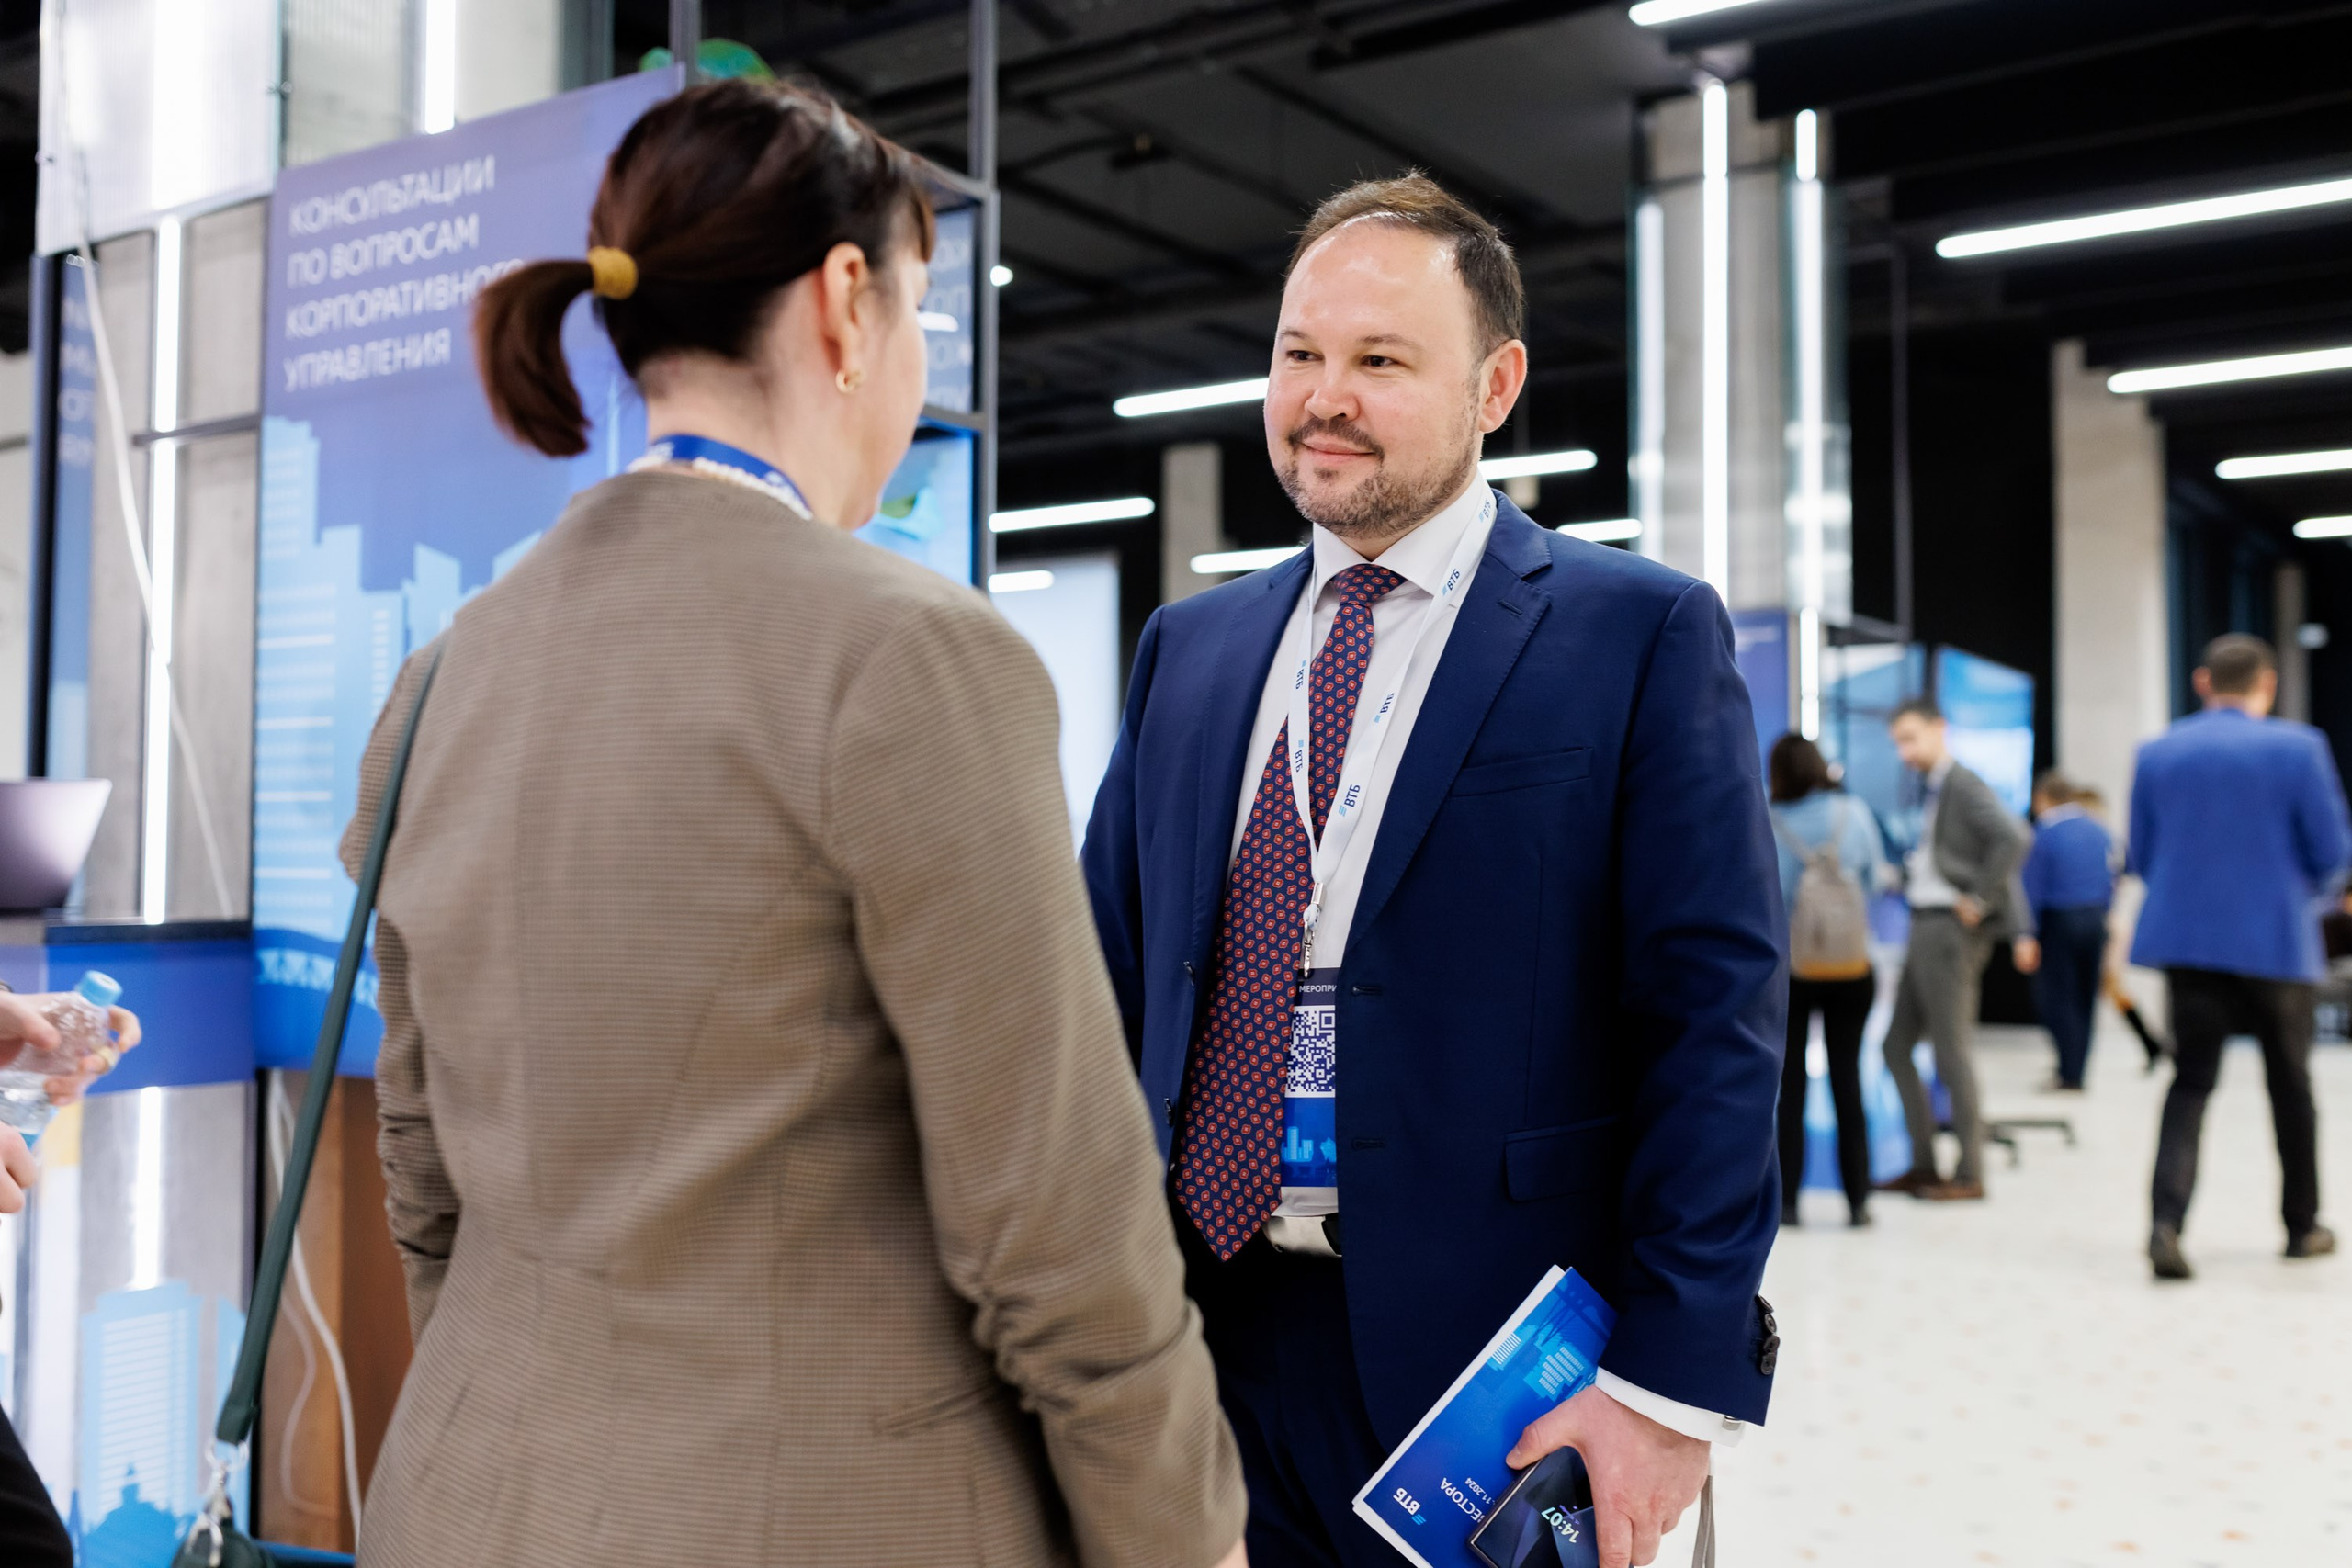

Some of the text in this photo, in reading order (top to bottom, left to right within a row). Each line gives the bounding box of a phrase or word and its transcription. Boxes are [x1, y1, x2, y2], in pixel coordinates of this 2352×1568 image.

[288, 155, 495, 236] КОНСУЛЬТАЦИИ
[287, 213, 479, 288] ПО ВОПРОСАМ
[283, 327, 451, 393] УПРАВЛЕНИЯ
[1447, 569, 1460, 591] ВТБ
[1380, 693, 1394, 714] ВТБ
[1295, 750, 1303, 773] ВТБ
[1344, 784, 1361, 807] ВТБ
[1393, 1488, 1421, 1516] ВТБ
[1541, 1506, 1580, 1543] 14:07
